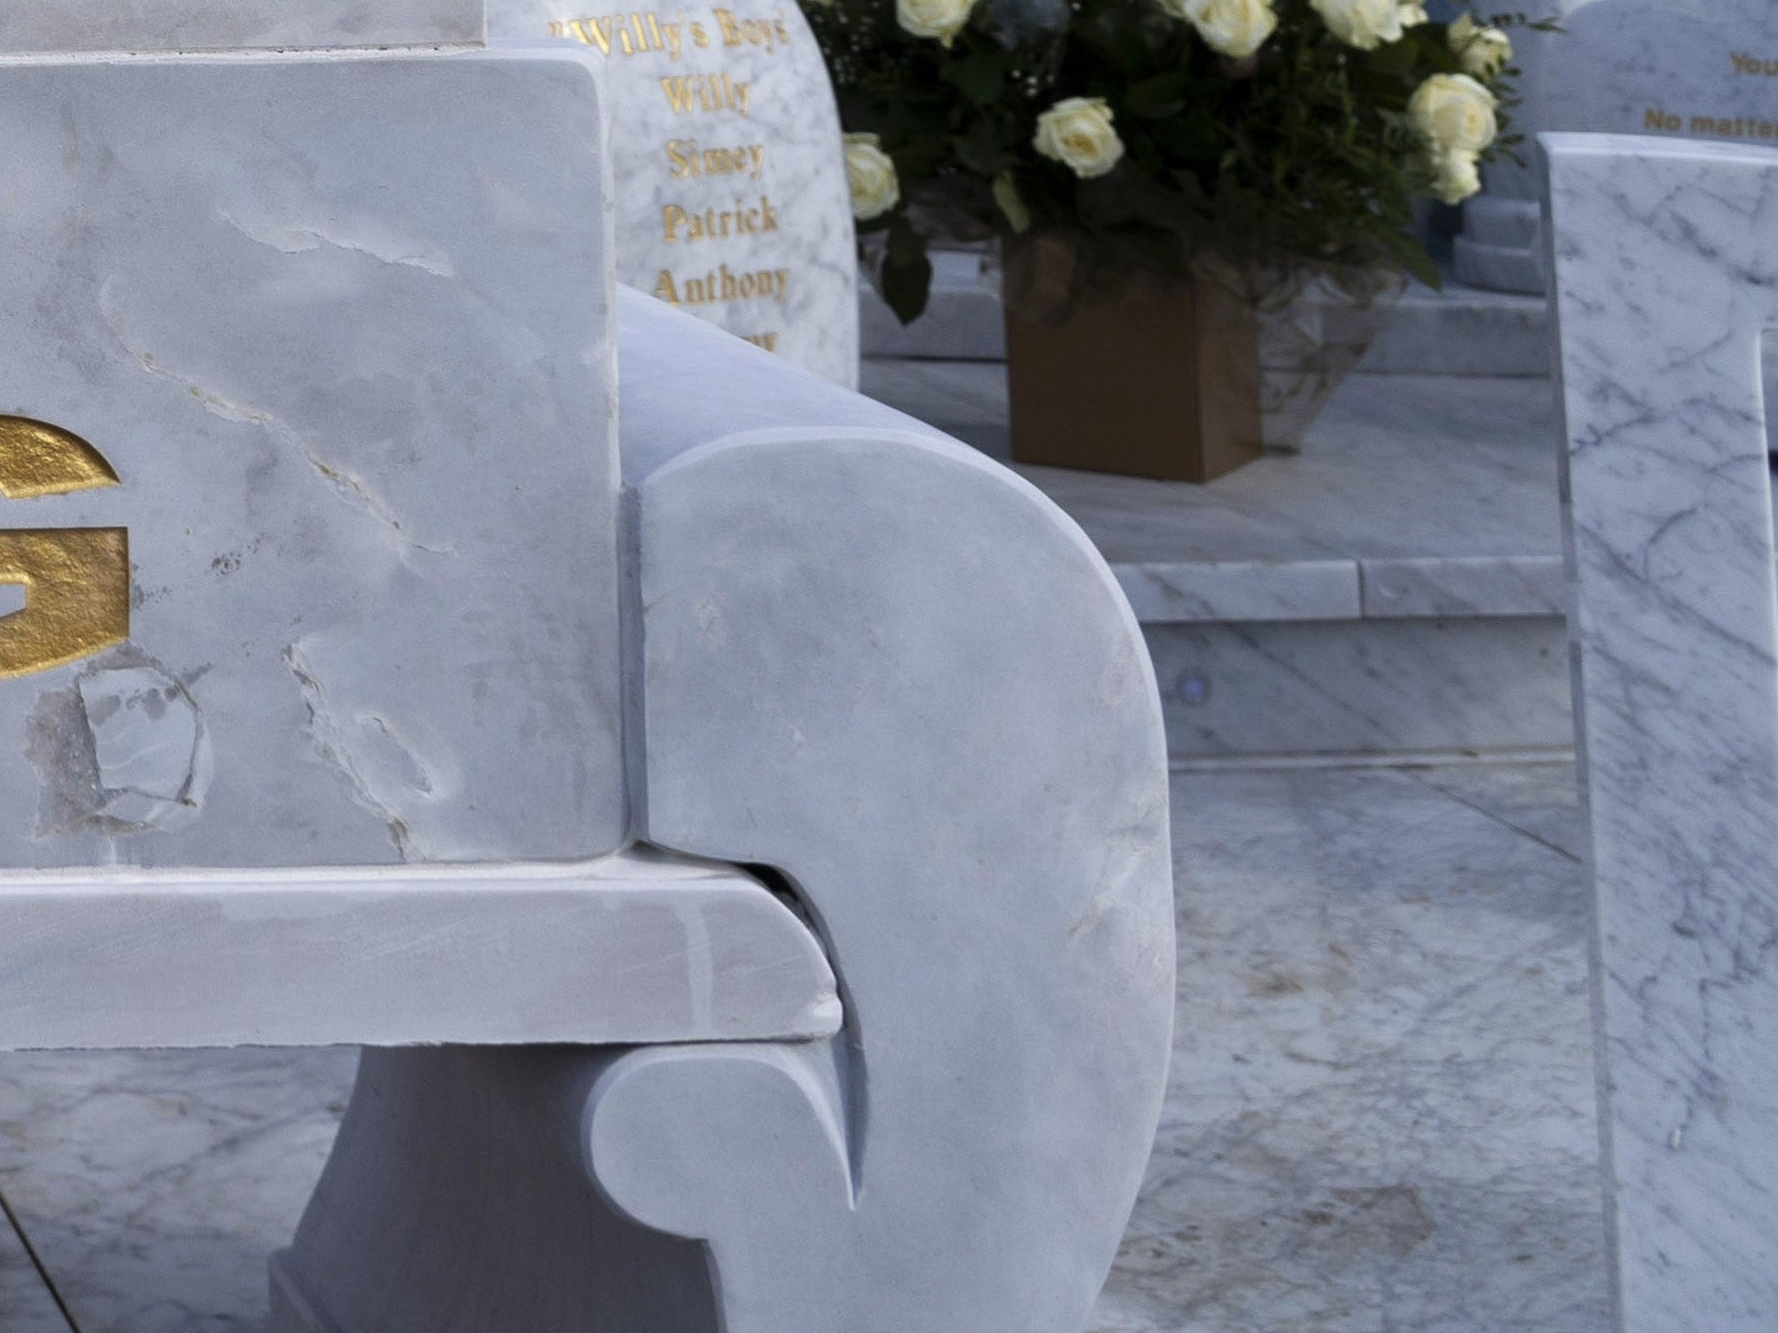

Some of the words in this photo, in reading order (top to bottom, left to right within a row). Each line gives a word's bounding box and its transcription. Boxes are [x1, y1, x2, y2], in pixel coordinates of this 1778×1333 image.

[660, 72, 752, 118] Willy
[1643, 107, 1683, 132] No
[664, 138, 765, 181] Simey
[662, 195, 779, 244] Patrick
[654, 263, 791, 307] Anthony
